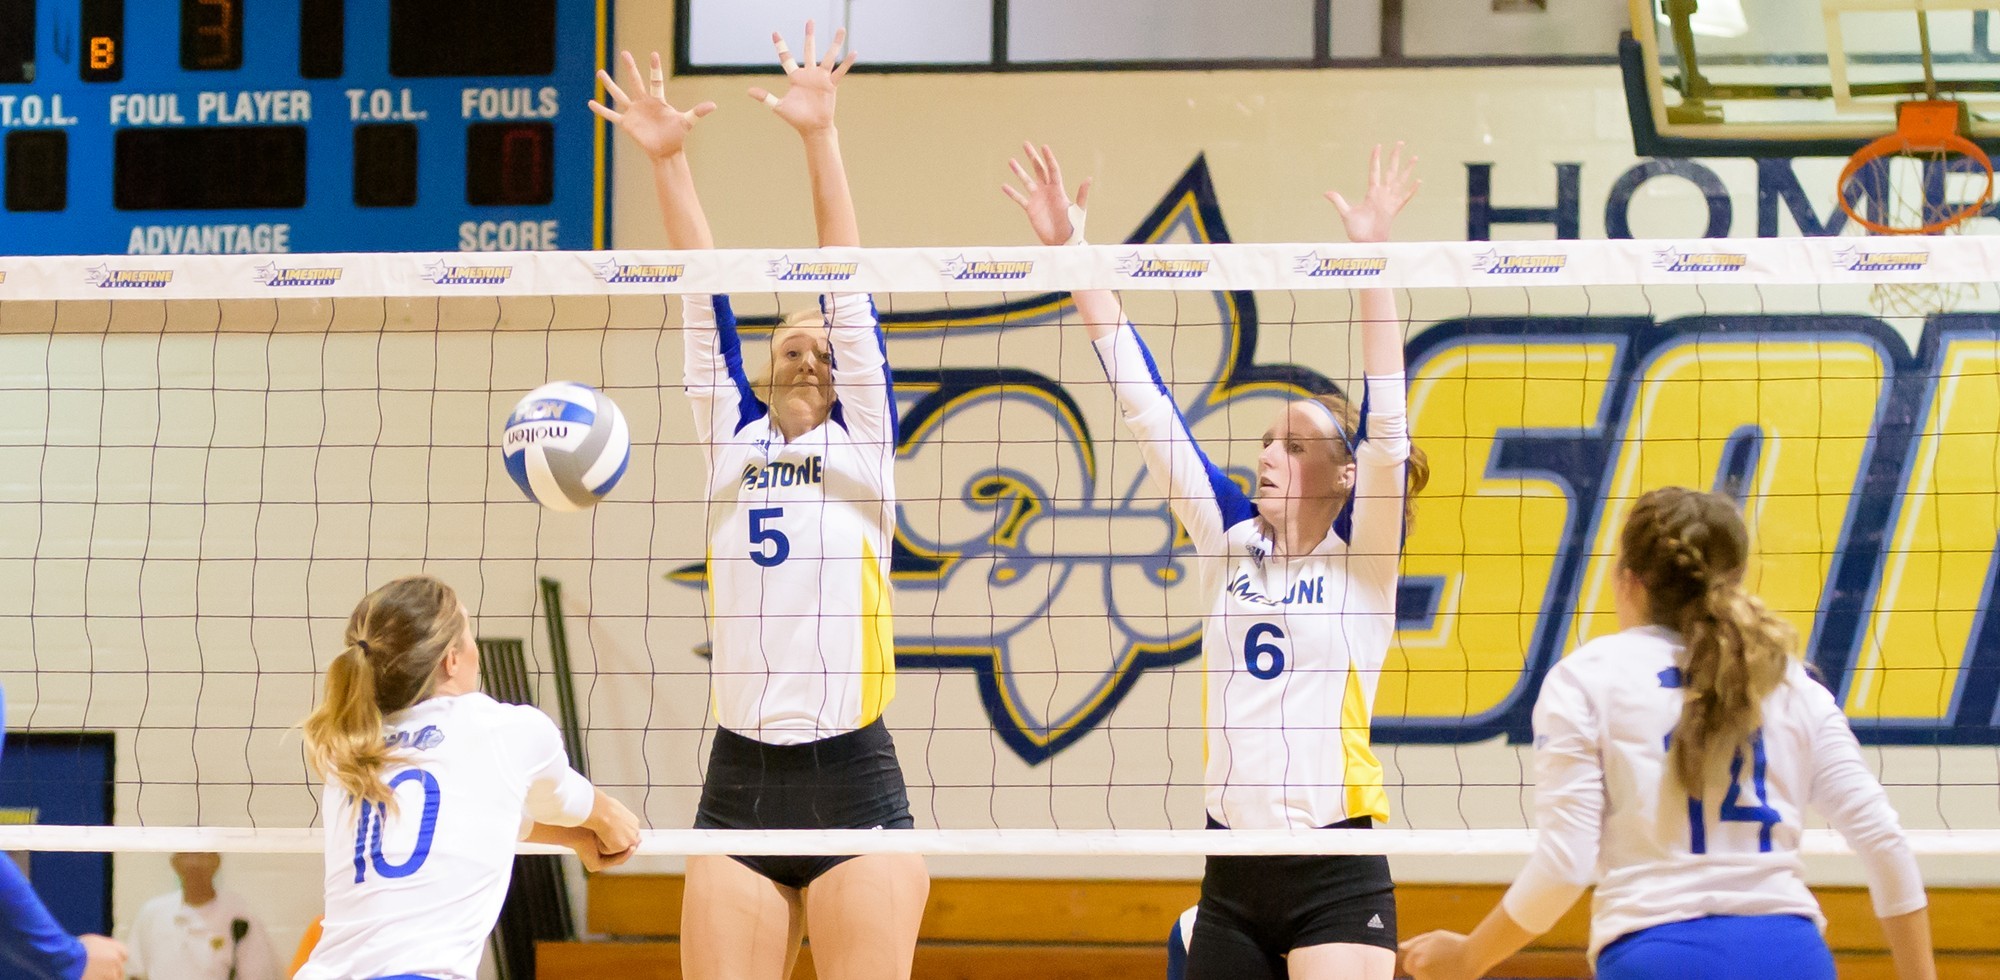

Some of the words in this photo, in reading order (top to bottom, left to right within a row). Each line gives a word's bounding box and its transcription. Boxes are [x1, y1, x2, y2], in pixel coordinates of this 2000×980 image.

[91, 37, 115, 69] B
[0, 96, 78, 126] T.O.L.
[110, 94, 184, 124] FOUL
[198, 90, 311, 122] PLAYER
[346, 90, 428, 121] T.O.L.
[461, 87, 560, 119] FOULS
[128, 224, 290, 254] ADVANTAGE
[458, 220, 560, 252] SCORE
[447, 266, 512, 278] LIMESTONE
[619, 264, 685, 277] LIMESTONE
[791, 263, 858, 275] LIMESTONE
[966, 261, 1033, 273] LIMESTONE
[1142, 259, 1209, 272] LIMESTONE
[1320, 257, 1387, 270] LIMESTONE
[1499, 254, 1567, 267] LIMESTONE
[110, 270, 173, 282] LIMESTONE
[278, 268, 343, 280] LIMESTONE
[508, 426, 568, 444] molten
[748, 507, 790, 567] 5
[1244, 622, 1285, 680] 6
[349, 769, 441, 884] 10
